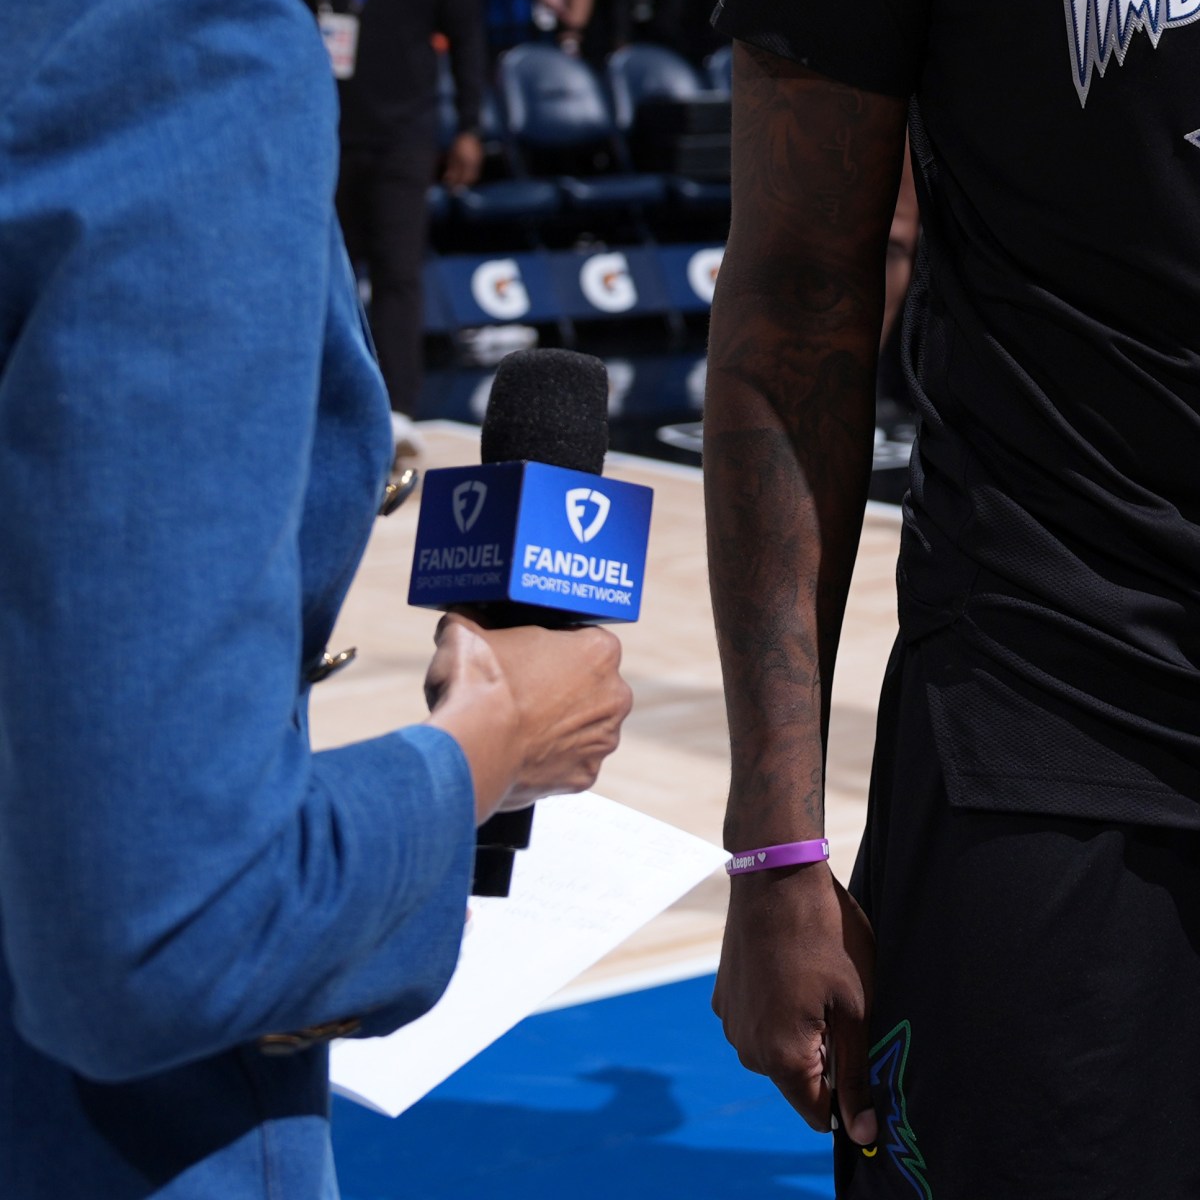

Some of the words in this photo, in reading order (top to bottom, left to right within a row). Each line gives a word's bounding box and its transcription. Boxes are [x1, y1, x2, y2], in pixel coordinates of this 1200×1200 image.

[470, 257, 531, 320] G
[579, 251, 638, 314] G
[418, 543, 504, 571] FANDUEL
[523, 544, 634, 588] FANDUEL
[416, 574, 453, 589] SPORTS
[454, 571, 502, 587] NETWORK
[520, 573, 571, 595] SPORTS
[571, 582, 632, 606] NETWORK
[732, 855, 755, 869] Keeper
